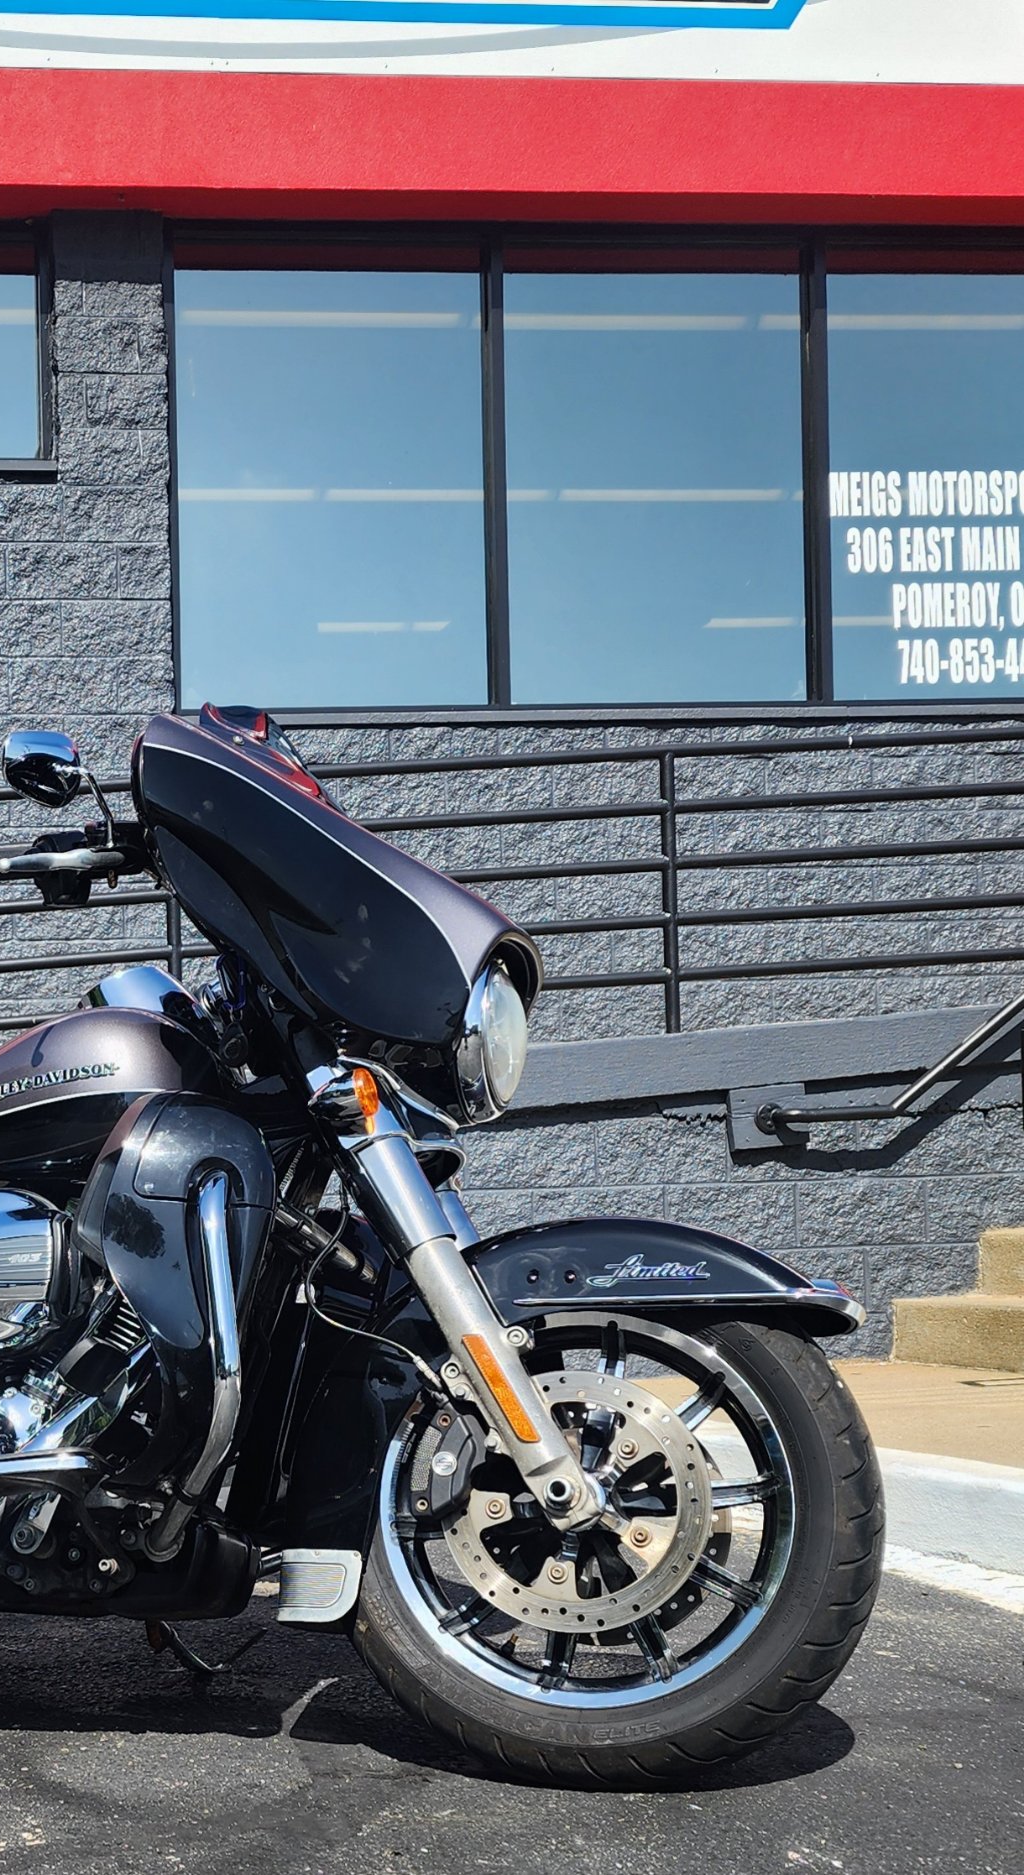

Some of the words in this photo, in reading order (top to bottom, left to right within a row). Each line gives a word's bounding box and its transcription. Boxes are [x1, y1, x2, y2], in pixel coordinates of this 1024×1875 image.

[829, 471, 902, 517] MEIGS
[847, 527, 893, 573] 306
[900, 526, 955, 572] EAST
[961, 526, 1020, 571] MAIN
[892, 582, 1005, 631] POMEROY,
[586, 1253, 711, 1287] Limited
[592, 1719, 661, 1742] ELITE
